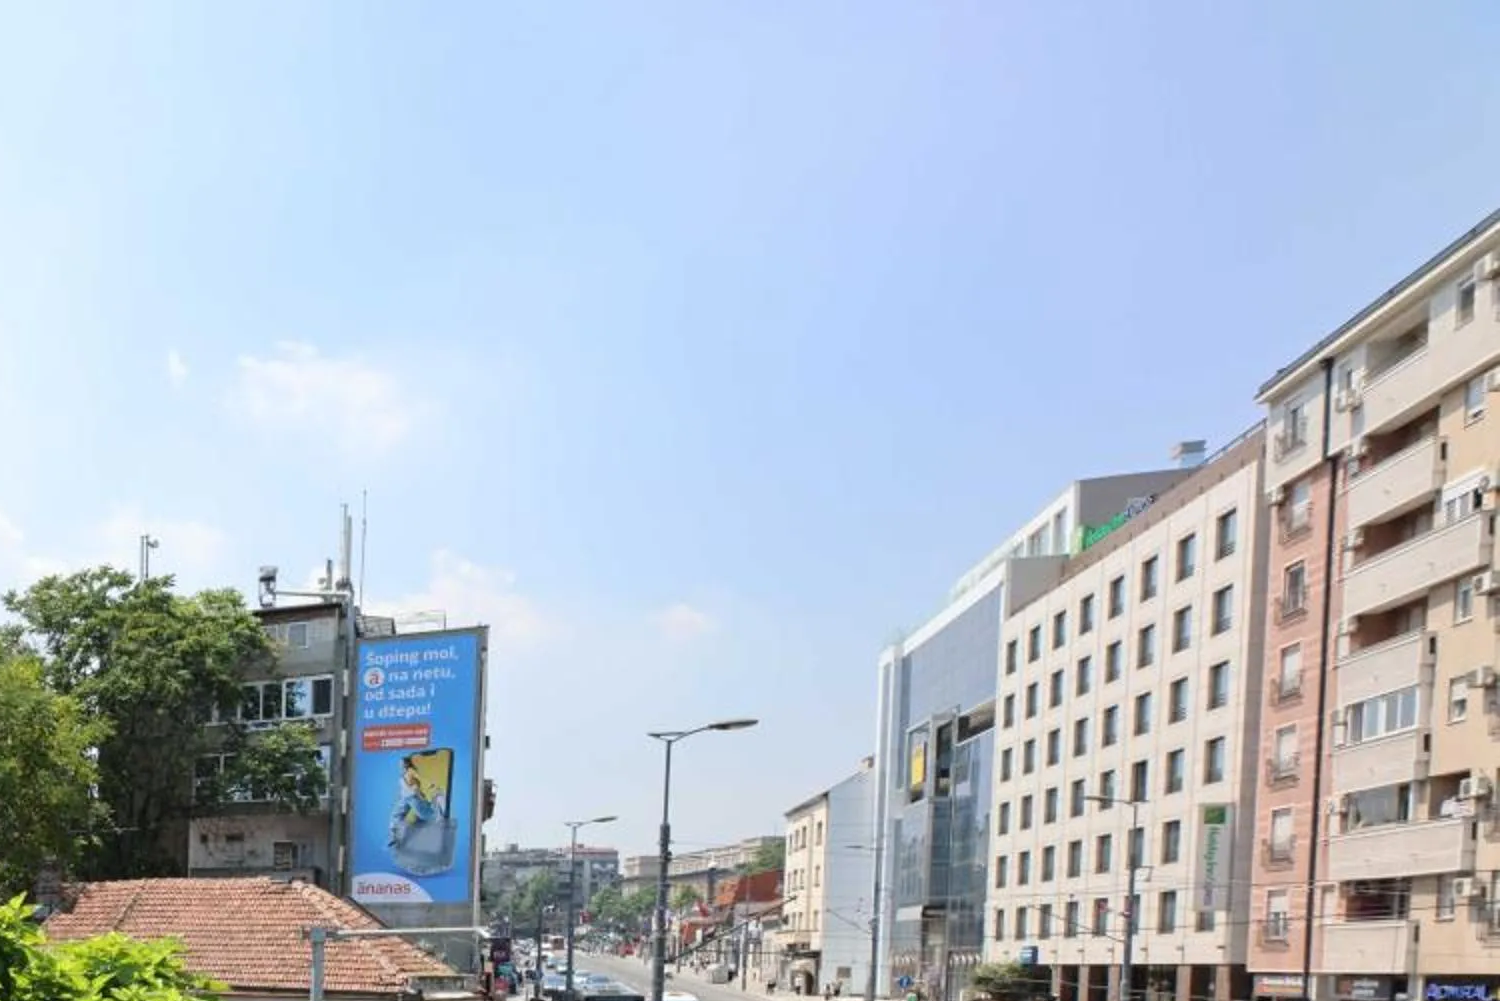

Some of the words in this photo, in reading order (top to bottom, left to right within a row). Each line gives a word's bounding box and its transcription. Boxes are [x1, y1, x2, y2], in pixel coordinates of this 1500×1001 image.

[387, 670, 409, 682] na
[365, 687, 385, 701] od
[387, 685, 426, 700] sada
[364, 707, 375, 719] u
